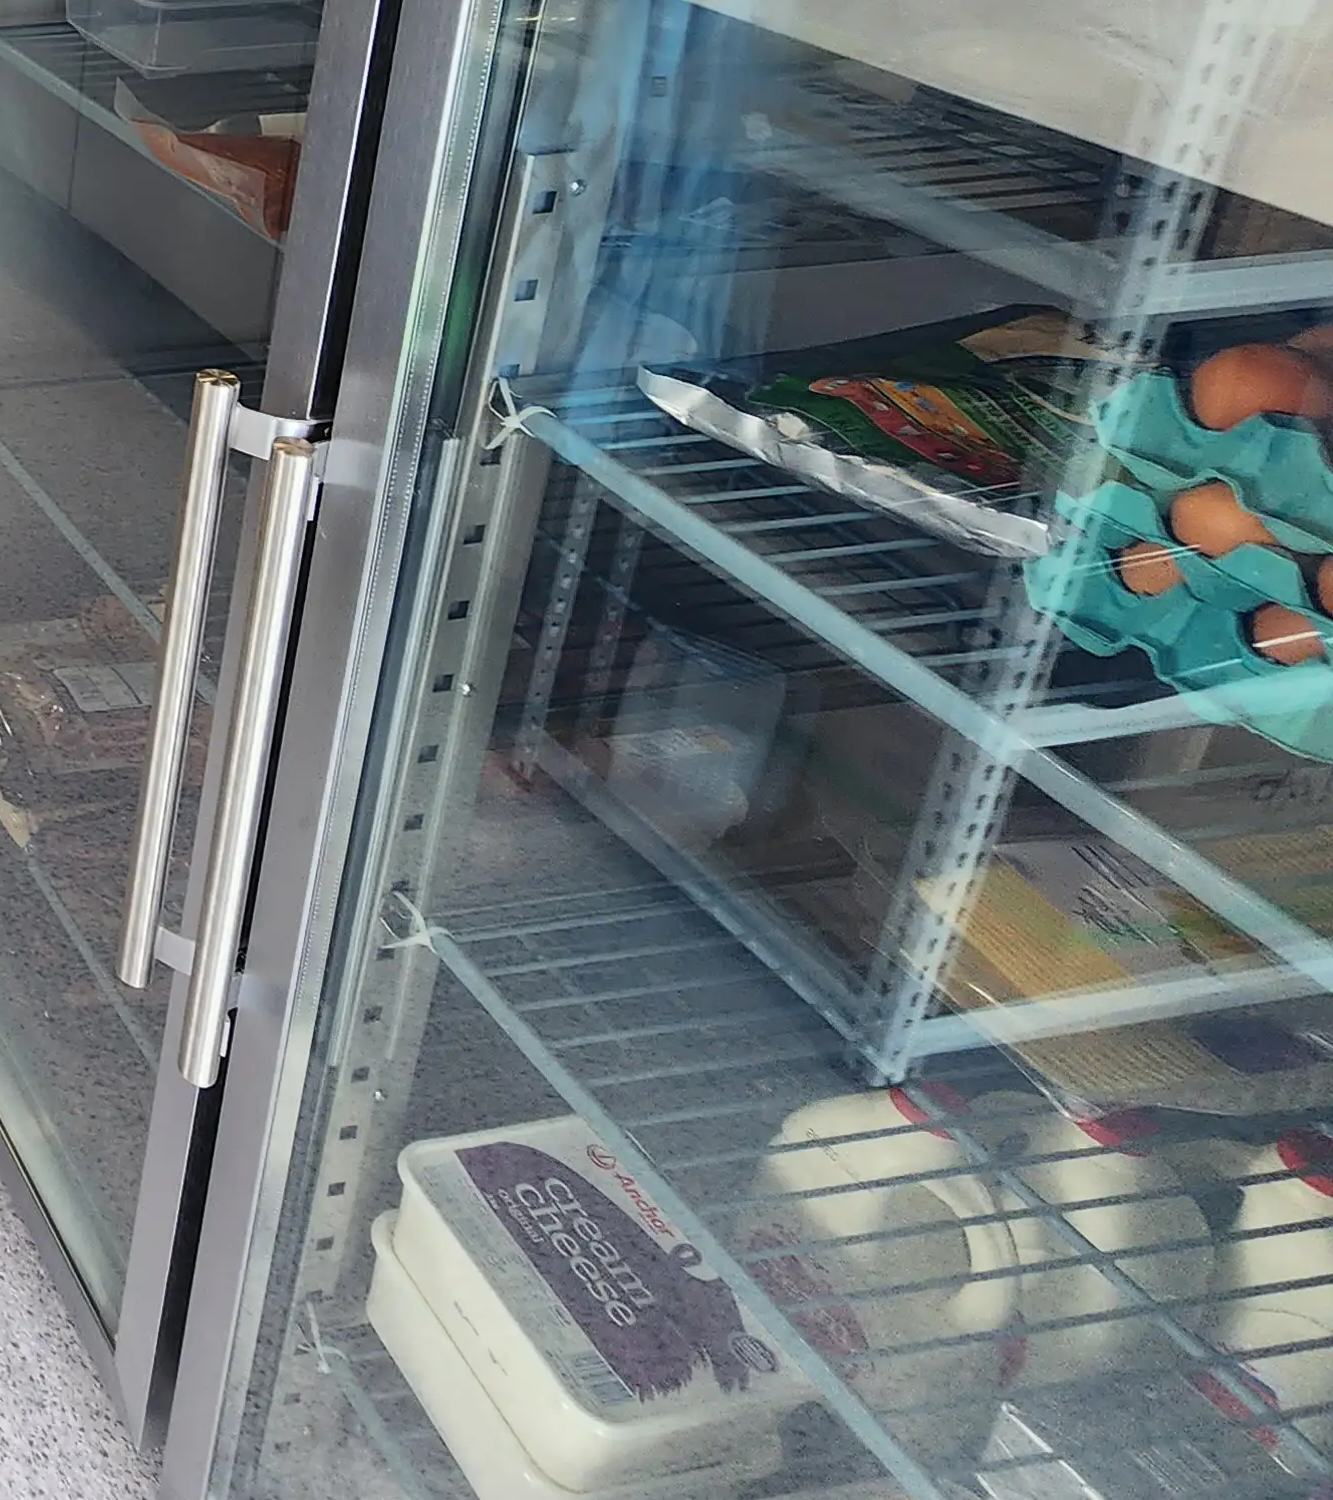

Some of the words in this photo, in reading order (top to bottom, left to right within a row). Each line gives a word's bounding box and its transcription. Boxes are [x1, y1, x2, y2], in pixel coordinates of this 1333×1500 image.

[515, 1182, 637, 1328] cheese
[545, 1177, 653, 1310] cream
[613, 1170, 676, 1238] Anchor
